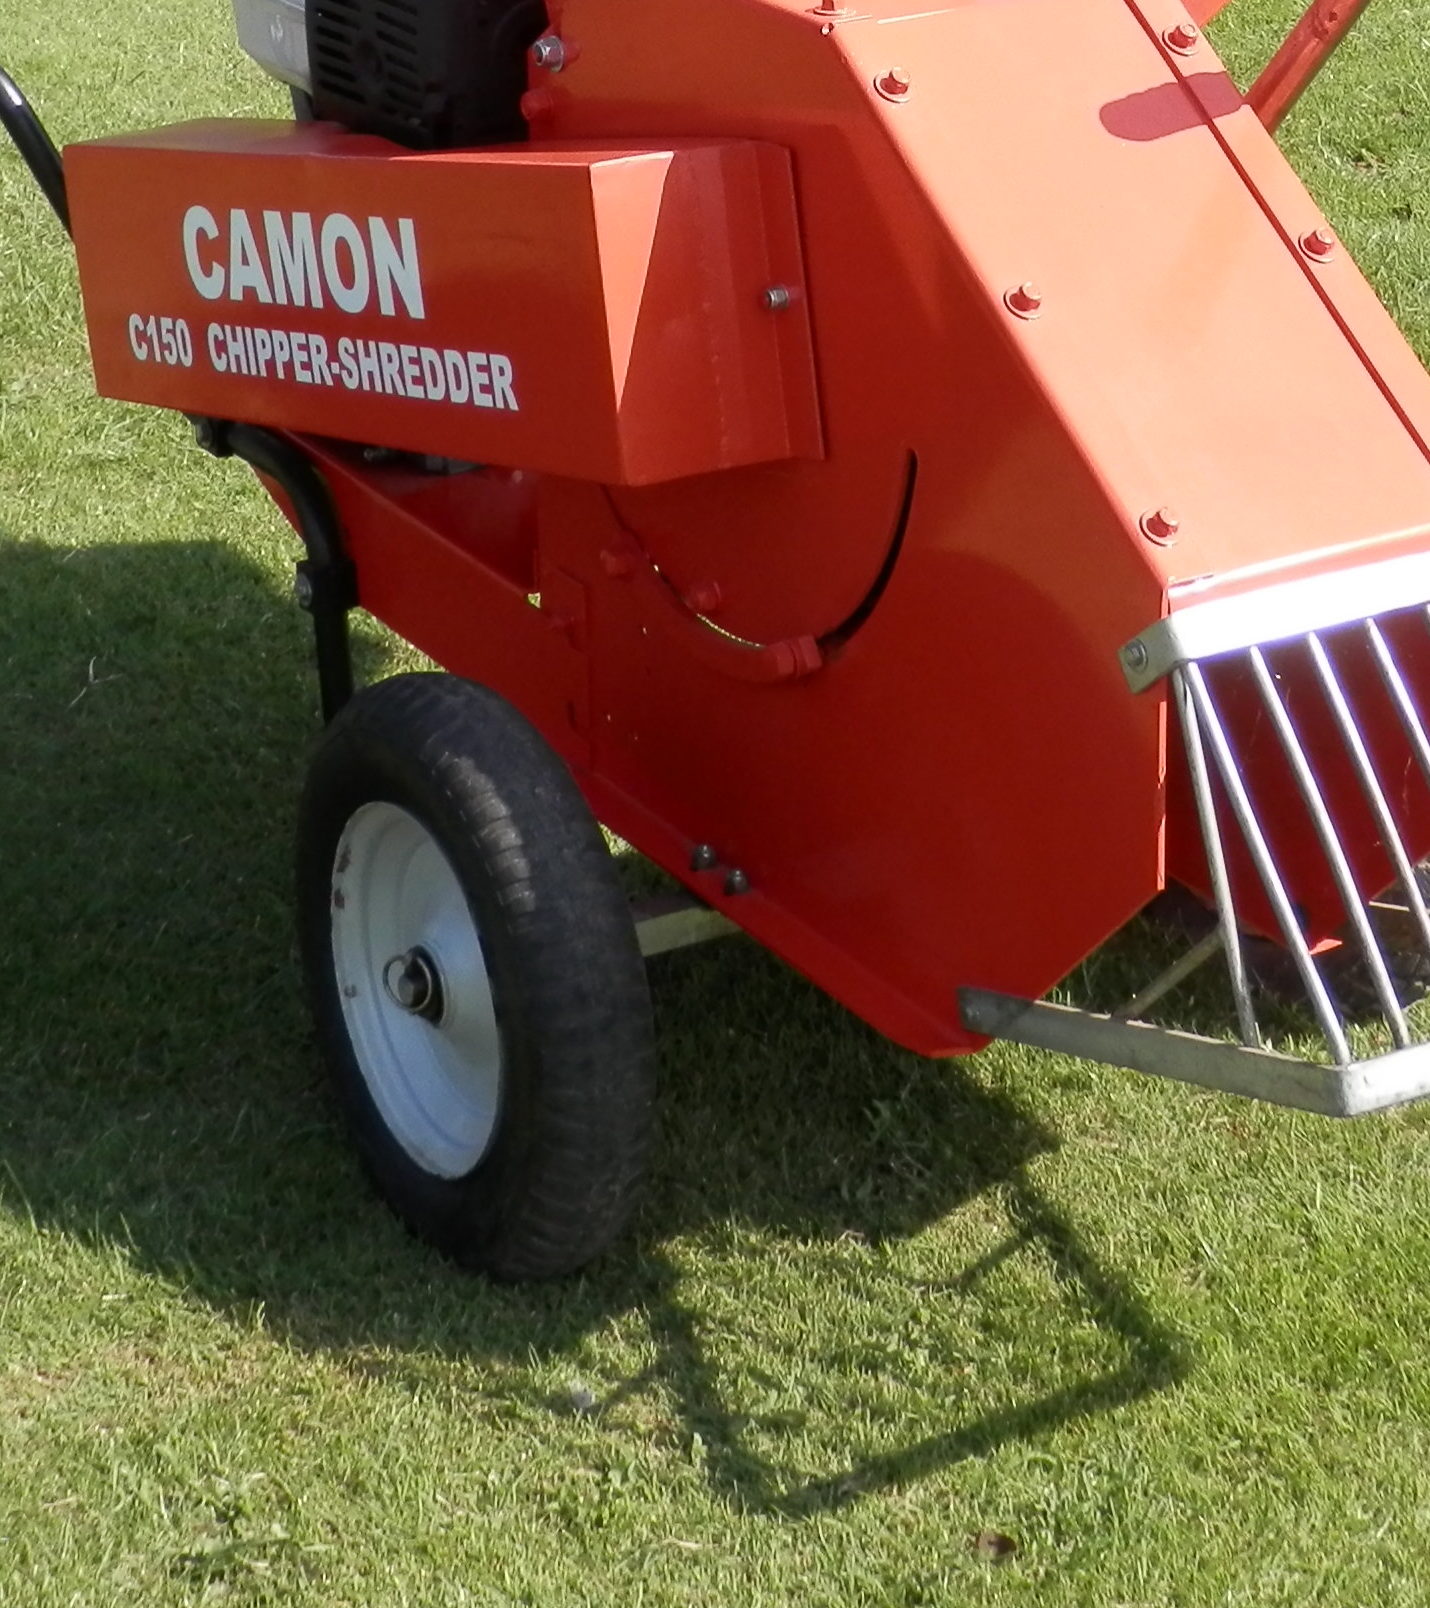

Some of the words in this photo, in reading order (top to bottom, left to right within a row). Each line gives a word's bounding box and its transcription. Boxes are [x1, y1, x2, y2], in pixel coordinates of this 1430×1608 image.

[181, 204, 426, 320] CAMON
[127, 313, 194, 369] C150
[205, 321, 520, 412] CHIPPER-SHREDDER
